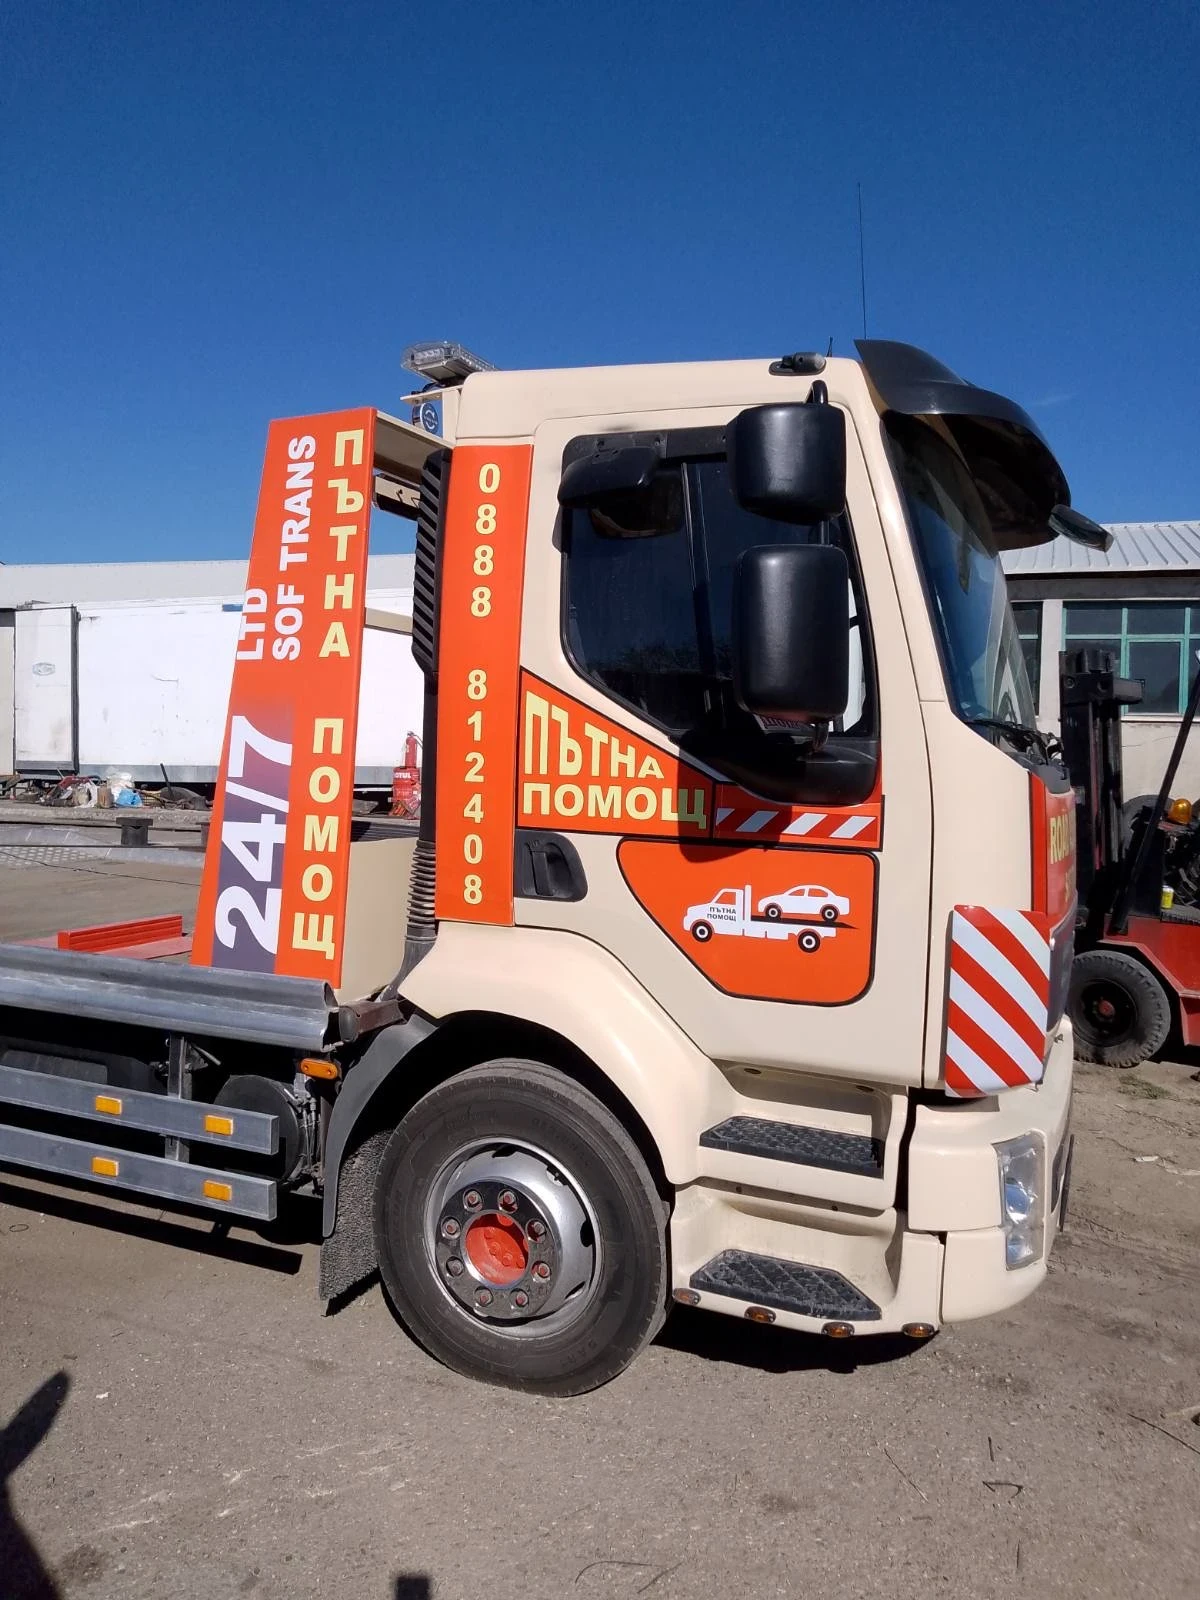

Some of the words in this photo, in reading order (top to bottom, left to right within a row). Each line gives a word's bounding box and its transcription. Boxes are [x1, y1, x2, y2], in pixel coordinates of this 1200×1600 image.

[280, 435, 316, 570] TRANS
[319, 429, 365, 658] ПЪТНА
[471, 463, 501, 617] 0888
[237, 588, 267, 660] LTD
[272, 584, 304, 660] SOF
[463, 669, 487, 904] 812408
[523, 783, 706, 828] ПОМОЩ
[524, 690, 664, 778] ПЪТНА
[215, 715, 292, 954] 24/7
[292, 717, 344, 960] ПОМОЩ
